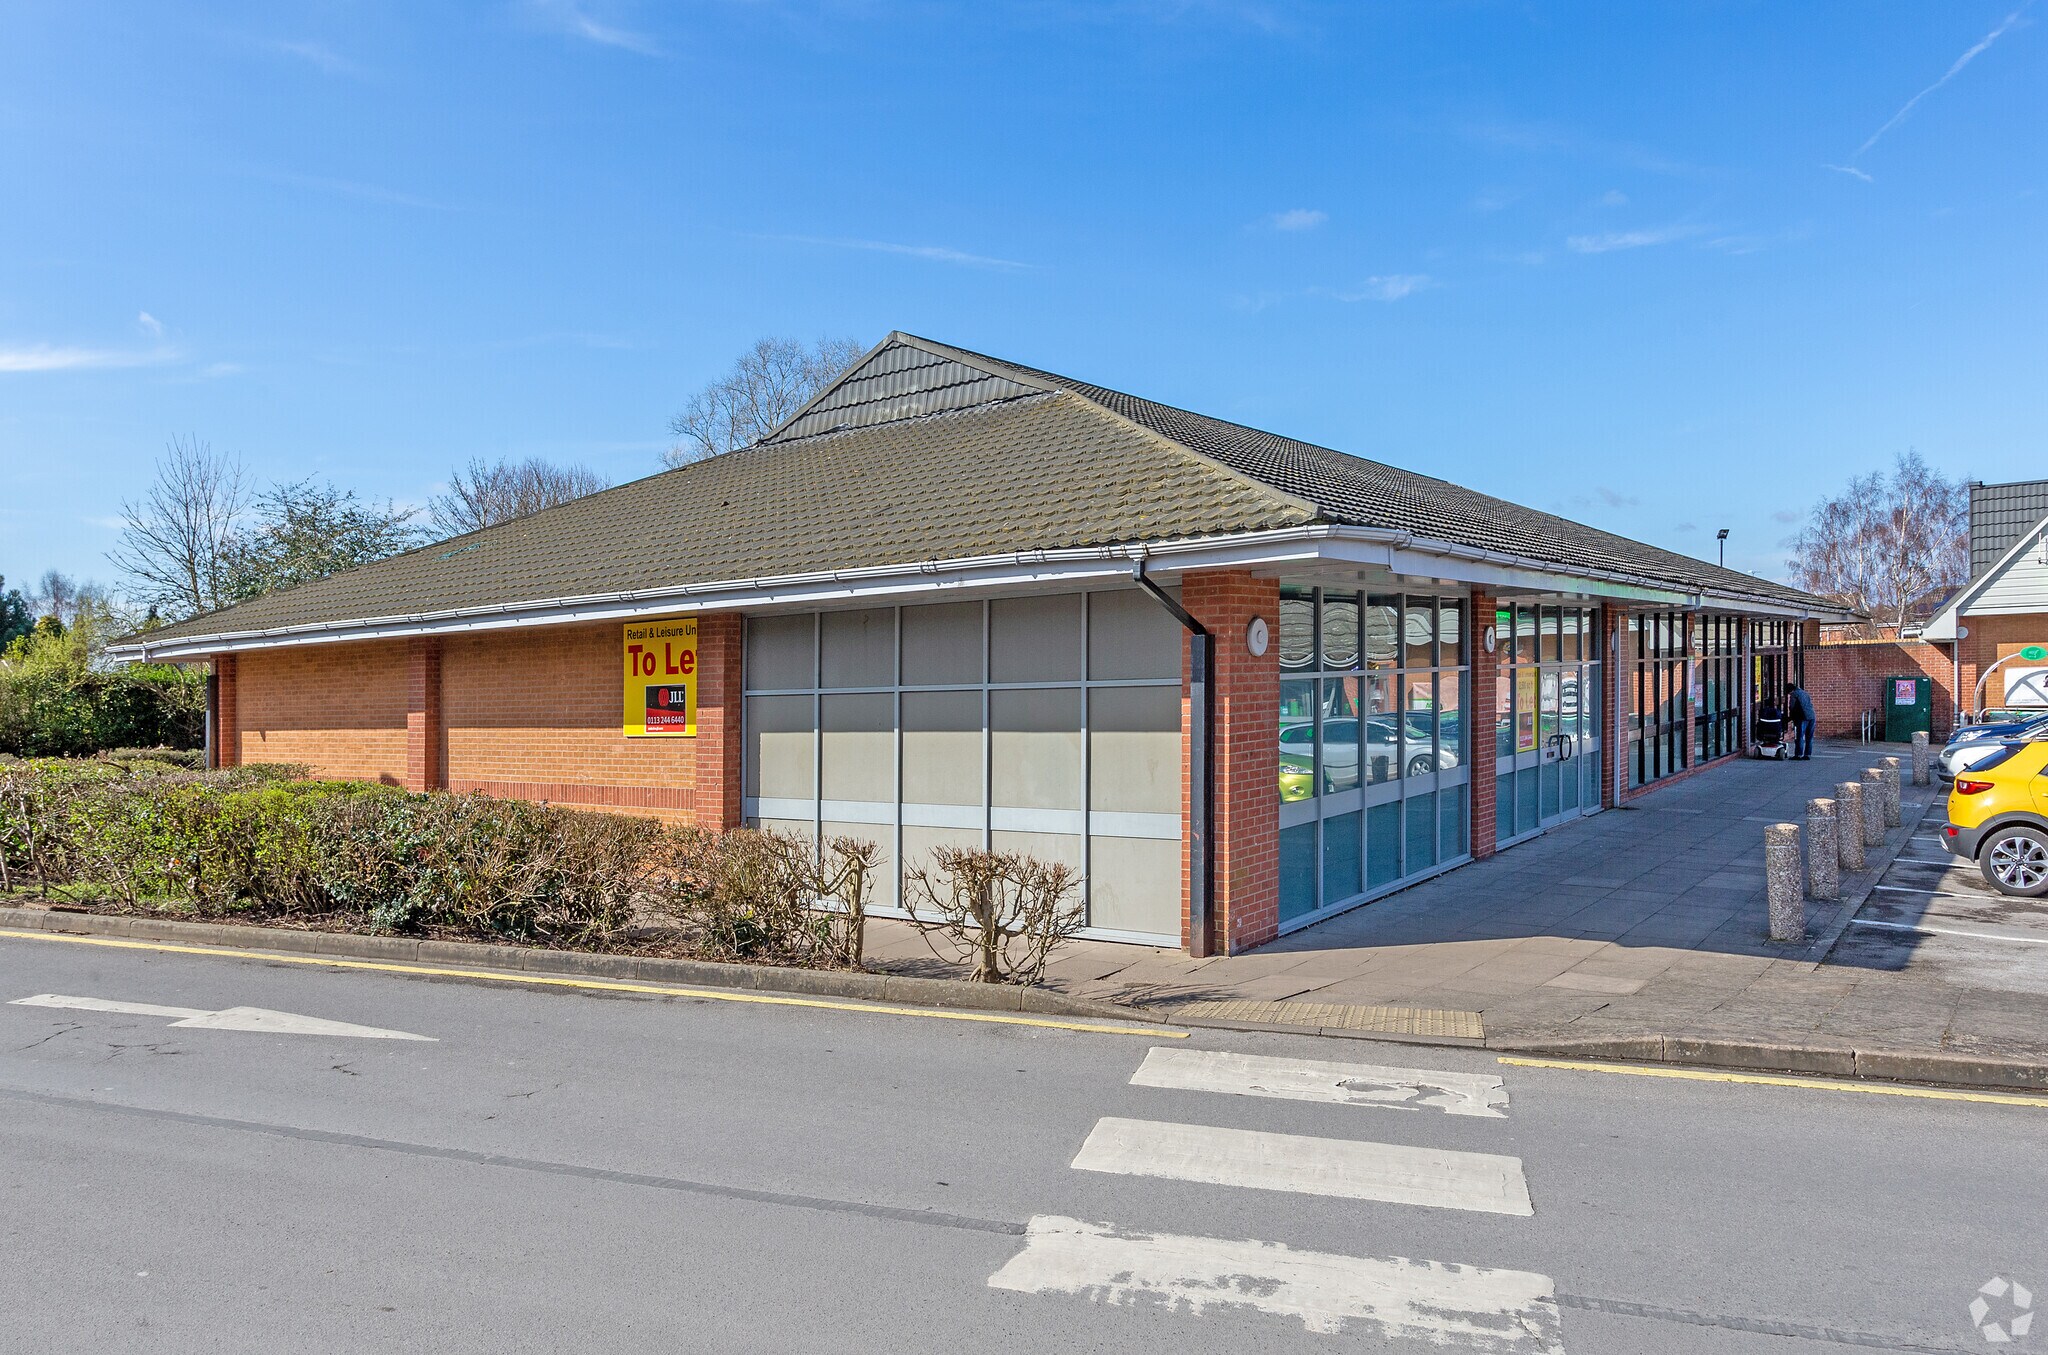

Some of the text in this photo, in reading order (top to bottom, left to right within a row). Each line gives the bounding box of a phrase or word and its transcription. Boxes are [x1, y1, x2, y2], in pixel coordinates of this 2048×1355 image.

[627, 628, 648, 640] Retail
[649, 627, 655, 638] &
[656, 626, 684, 637] Leisure
[628, 644, 656, 676] To
[669, 691, 684, 703] JLL
[647, 715, 685, 725] 0113 244 6440
